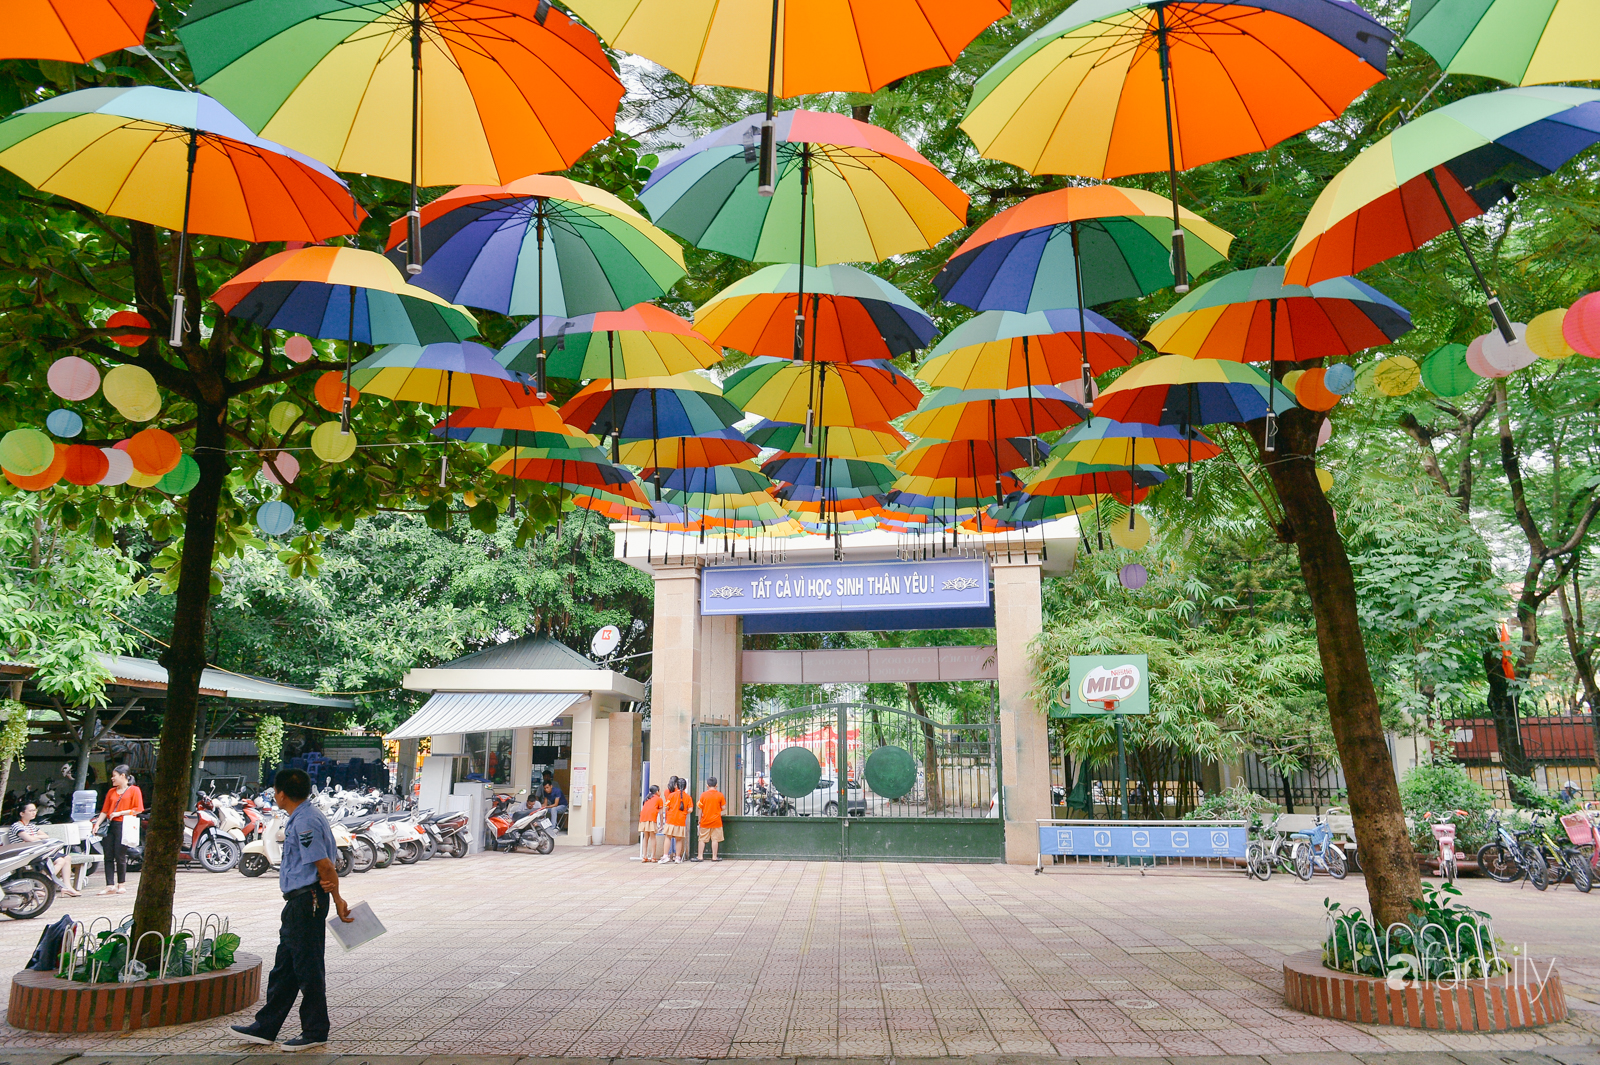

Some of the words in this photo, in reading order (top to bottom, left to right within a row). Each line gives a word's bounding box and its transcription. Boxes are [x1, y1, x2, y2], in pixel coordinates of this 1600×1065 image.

[751, 576, 772, 599] TẤT
[775, 574, 792, 598] CẢ
[794, 575, 805, 597] VÌ
[808, 579, 832, 600] HỌC
[836, 577, 864, 596] SINH
[867, 573, 900, 596] THÂN
[904, 571, 928, 594] YÊU
[1087, 675, 1134, 694] MILO
